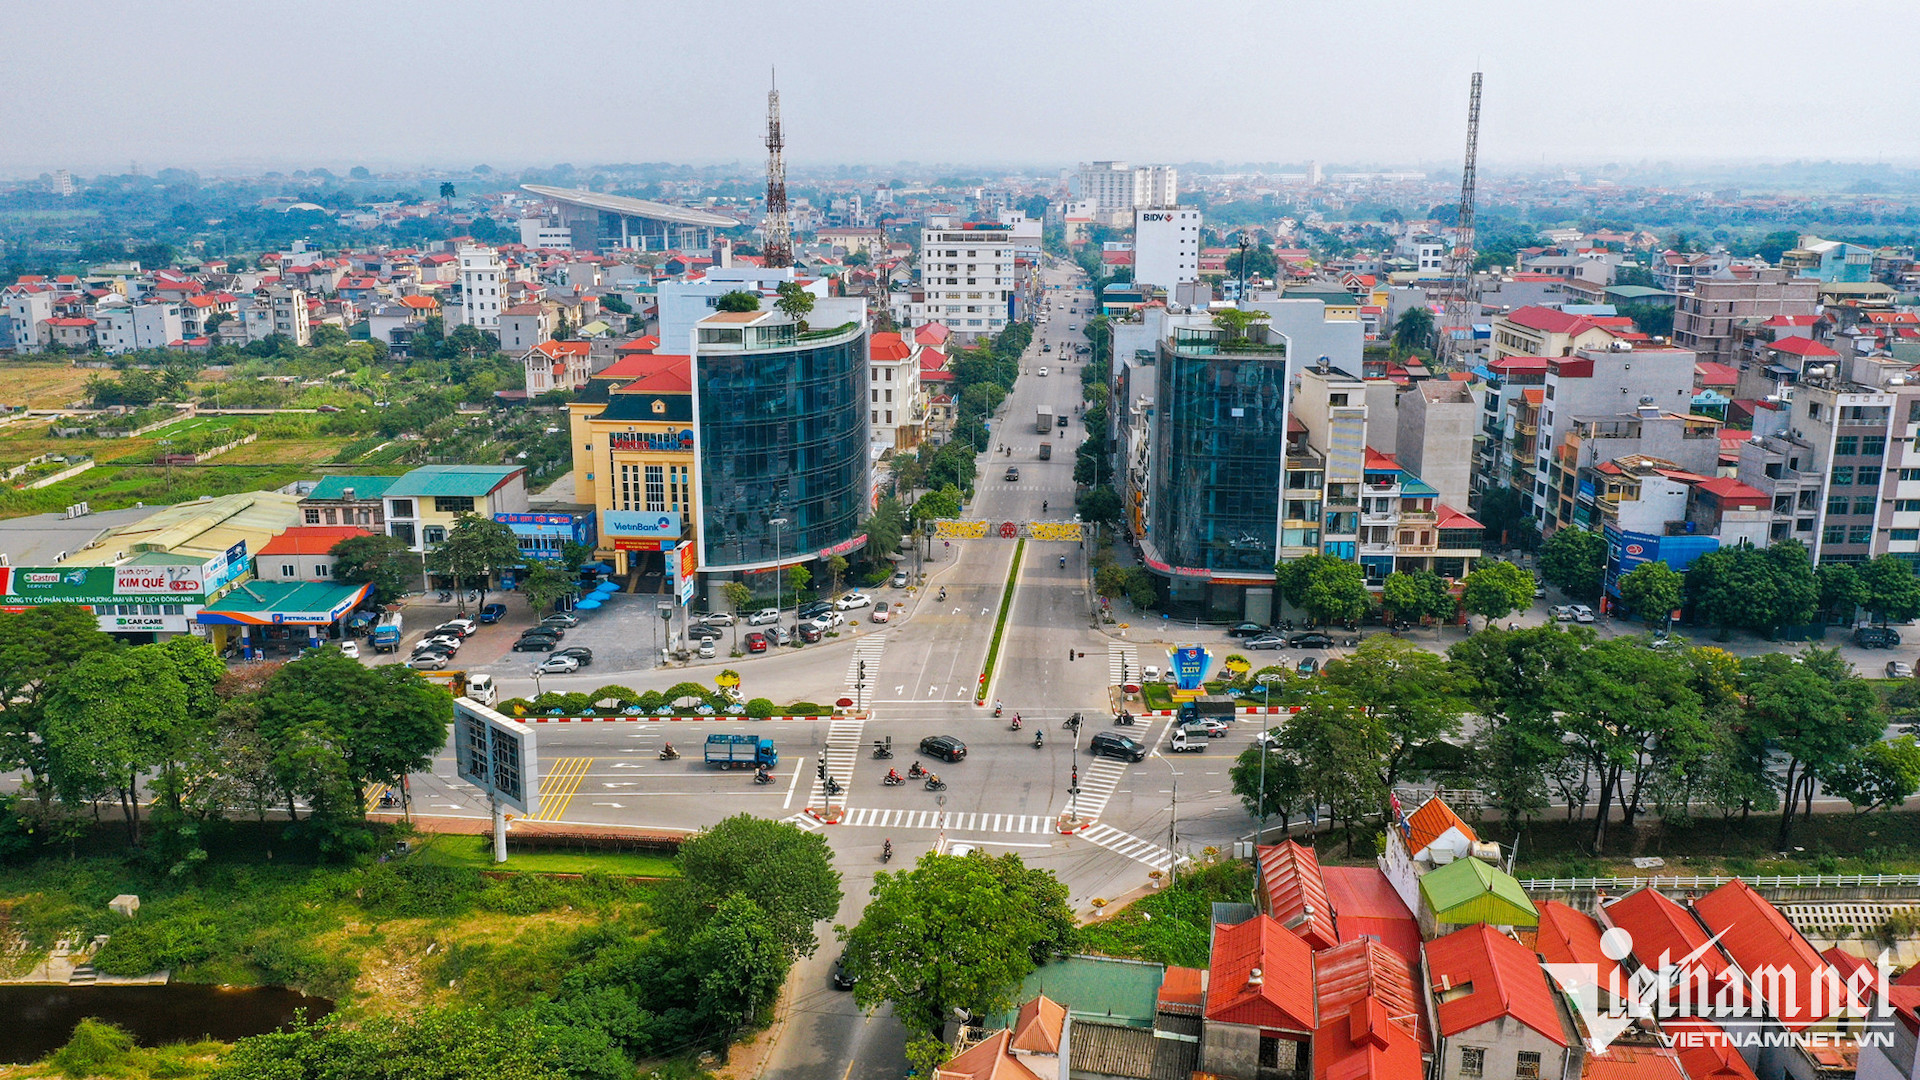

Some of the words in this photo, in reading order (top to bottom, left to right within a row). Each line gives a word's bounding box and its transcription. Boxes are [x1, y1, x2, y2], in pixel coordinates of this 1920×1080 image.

[1143, 213, 1164, 221] BIDV
[613, 521, 659, 531] VietinBank
[1175, 566, 1211, 577] TOWER
[32, 574, 58, 582] Castrol
[118, 578, 139, 588] KIM
